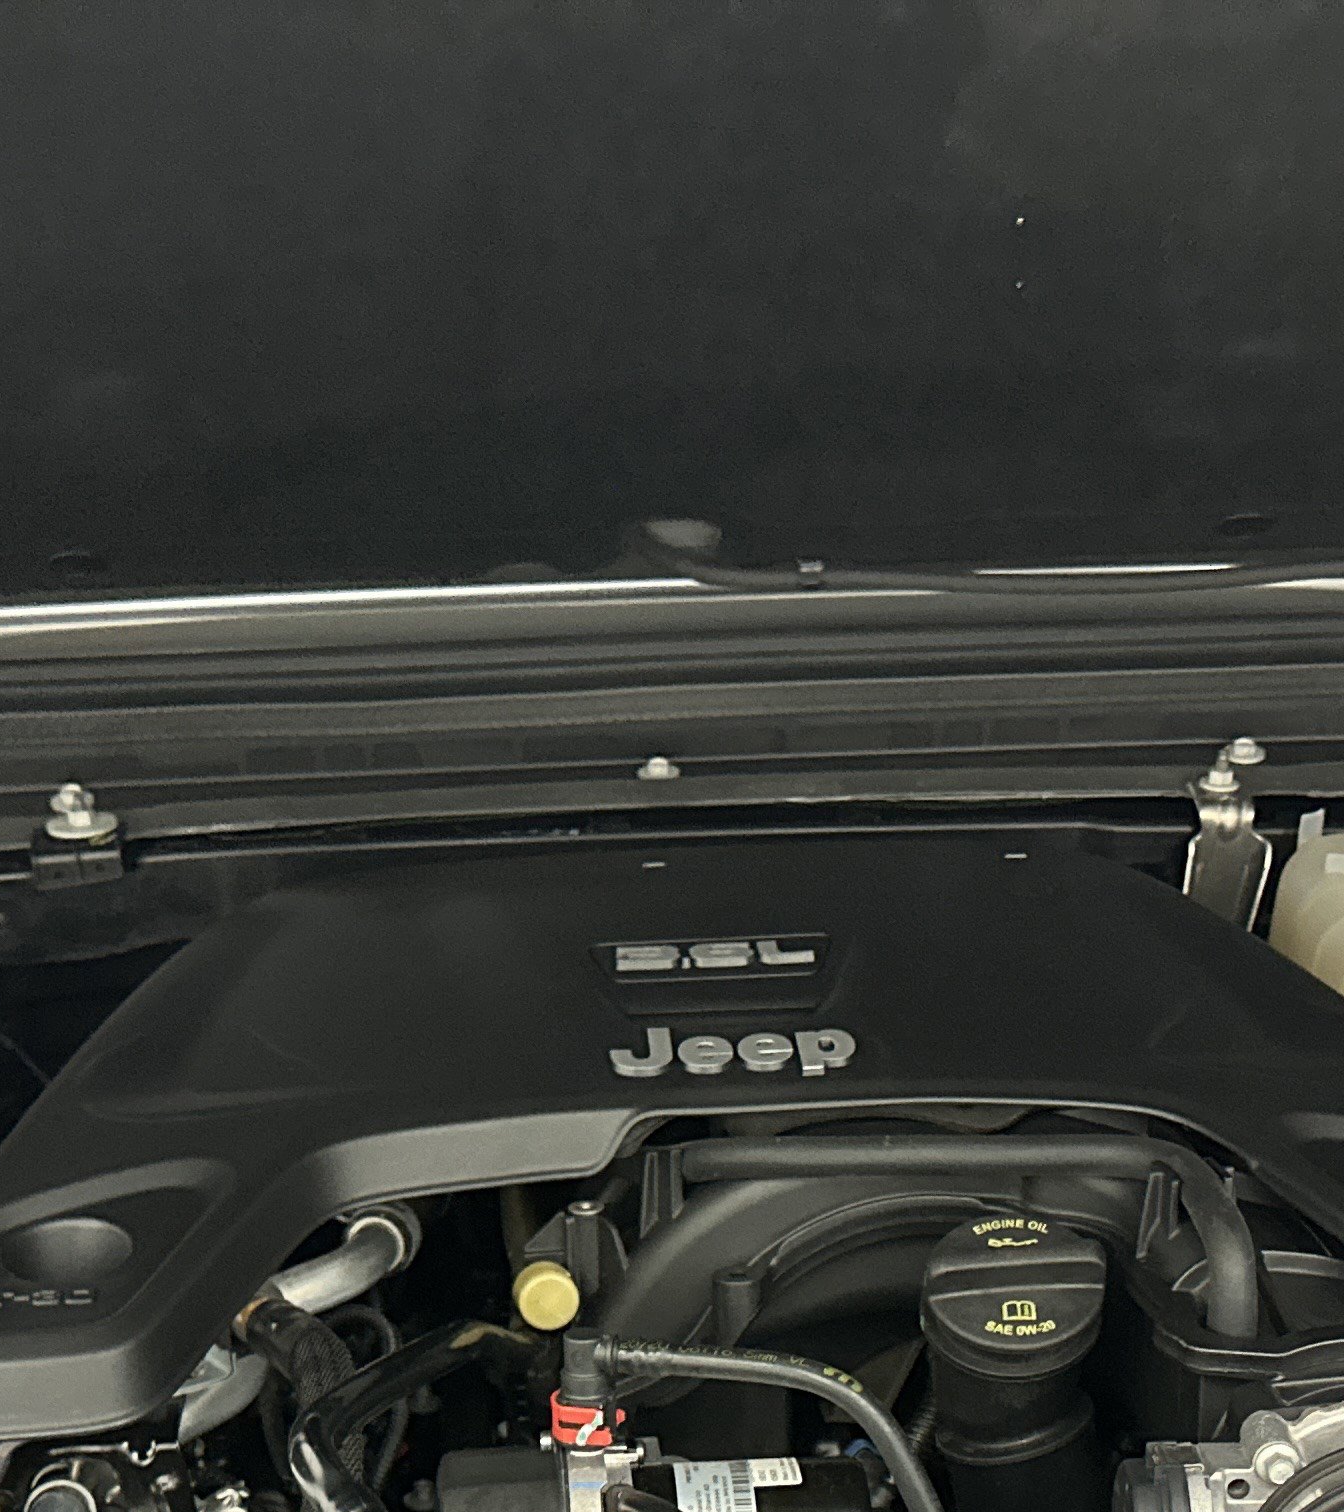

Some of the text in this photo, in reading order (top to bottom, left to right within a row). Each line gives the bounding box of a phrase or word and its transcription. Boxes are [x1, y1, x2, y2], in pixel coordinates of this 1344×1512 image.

[609, 1027, 856, 1077] Jeep
[972, 1219, 1049, 1235] ENGINE OIL
[984, 1320, 1056, 1336] SAE 0W-20
